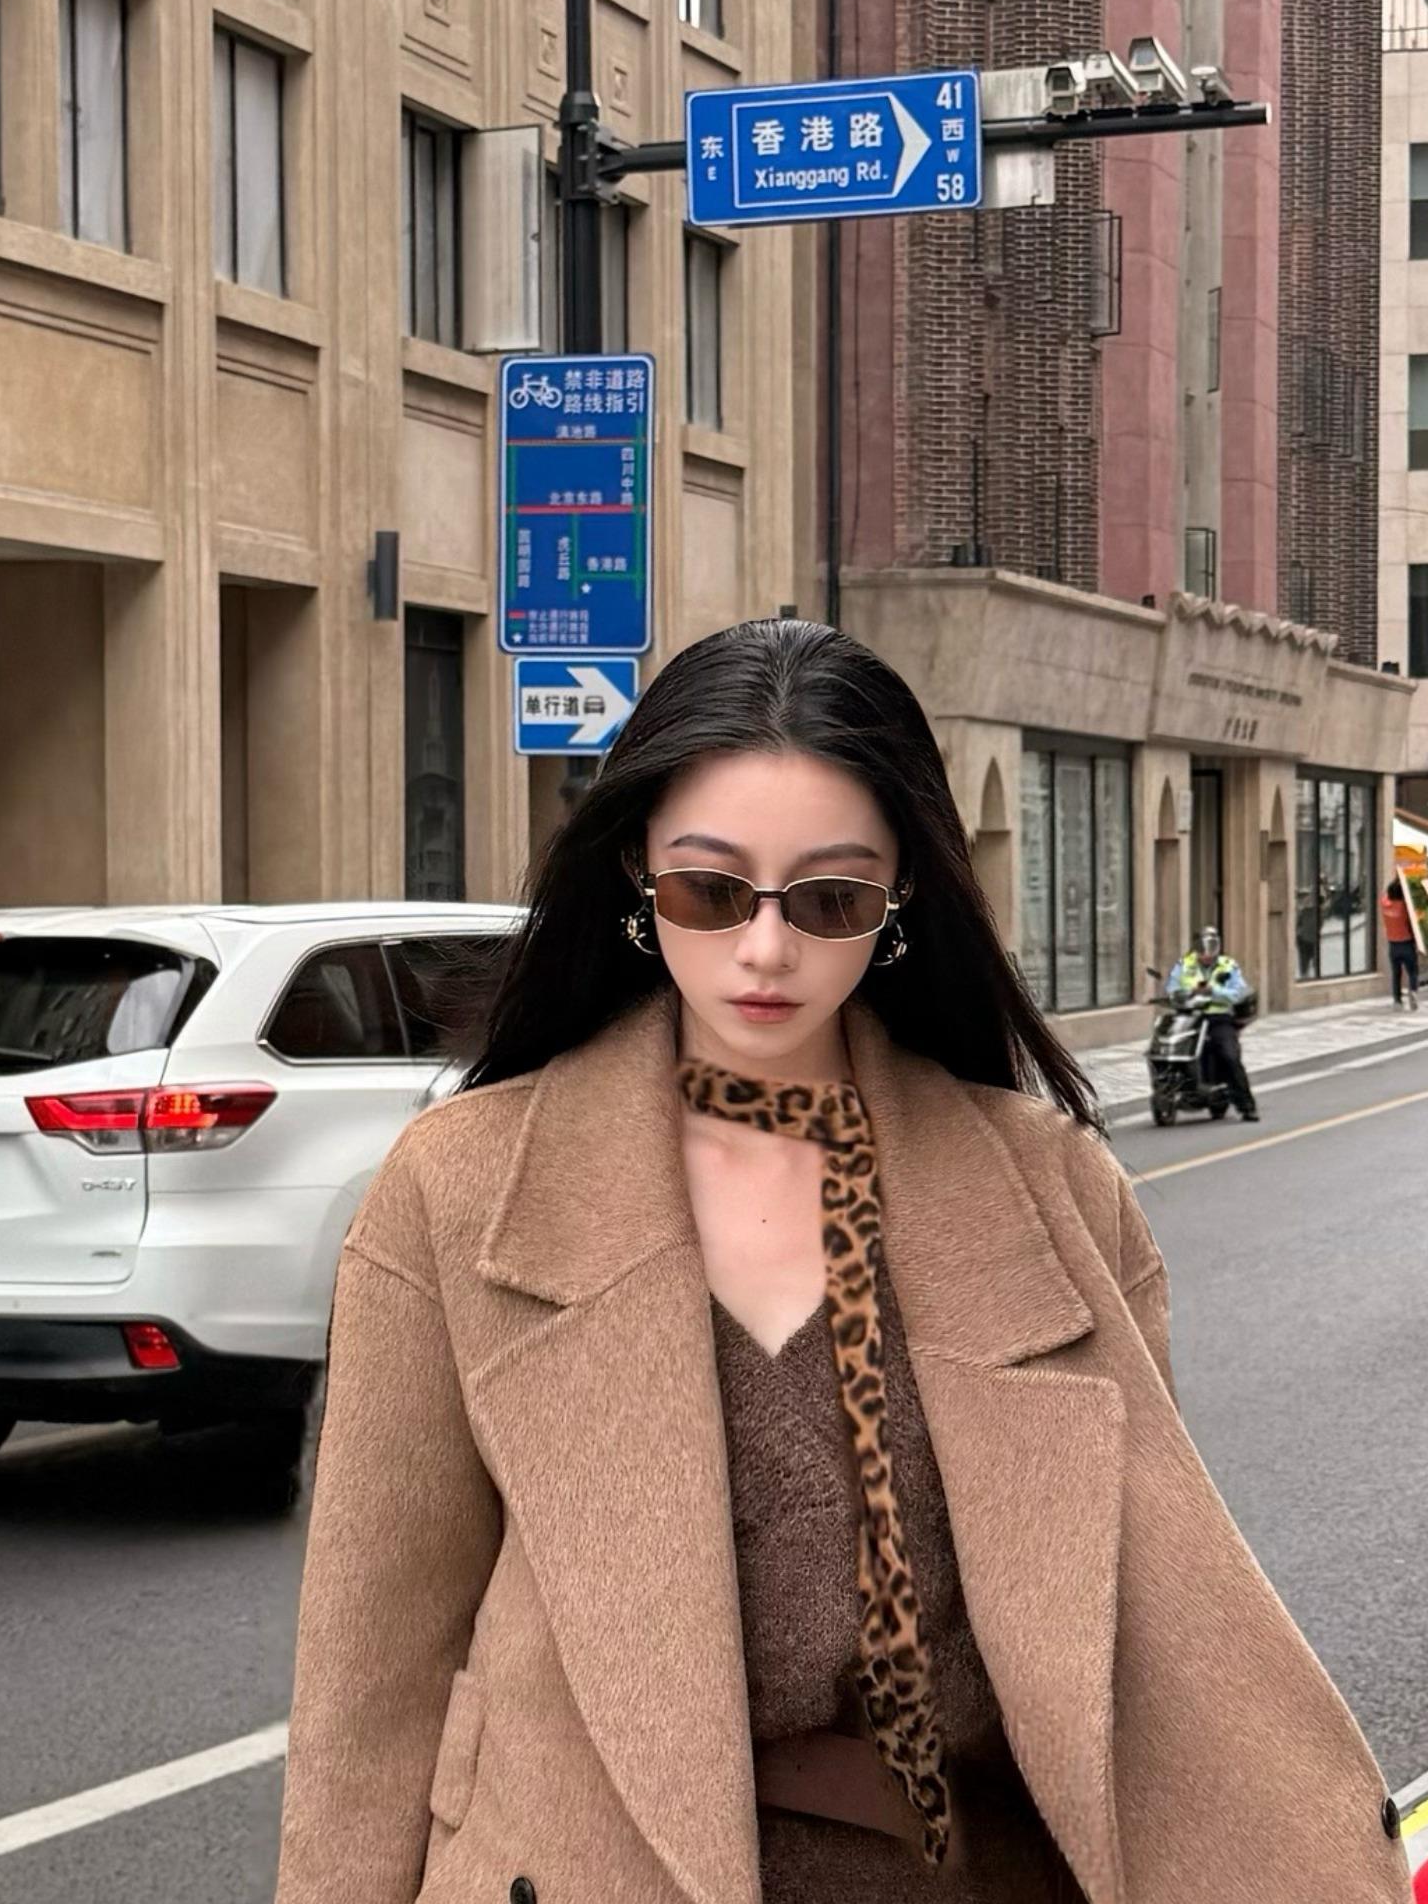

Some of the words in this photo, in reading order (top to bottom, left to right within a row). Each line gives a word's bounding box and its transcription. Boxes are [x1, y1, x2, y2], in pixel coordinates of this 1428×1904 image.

[937, 82, 963, 110] 41
[751, 112, 884, 156] 香港路
[941, 118, 964, 142] 西
[700, 136, 724, 160] 东
[946, 149, 960, 163] W
[707, 166, 717, 181] E
[755, 164, 850, 191] Xianggang
[856, 160, 889, 181] Rd.
[937, 173, 964, 201] 58
[564, 368, 645, 391] 禁非道路
[563, 391, 644, 414] 路线指引
[525, 695, 579, 716] 单行道
